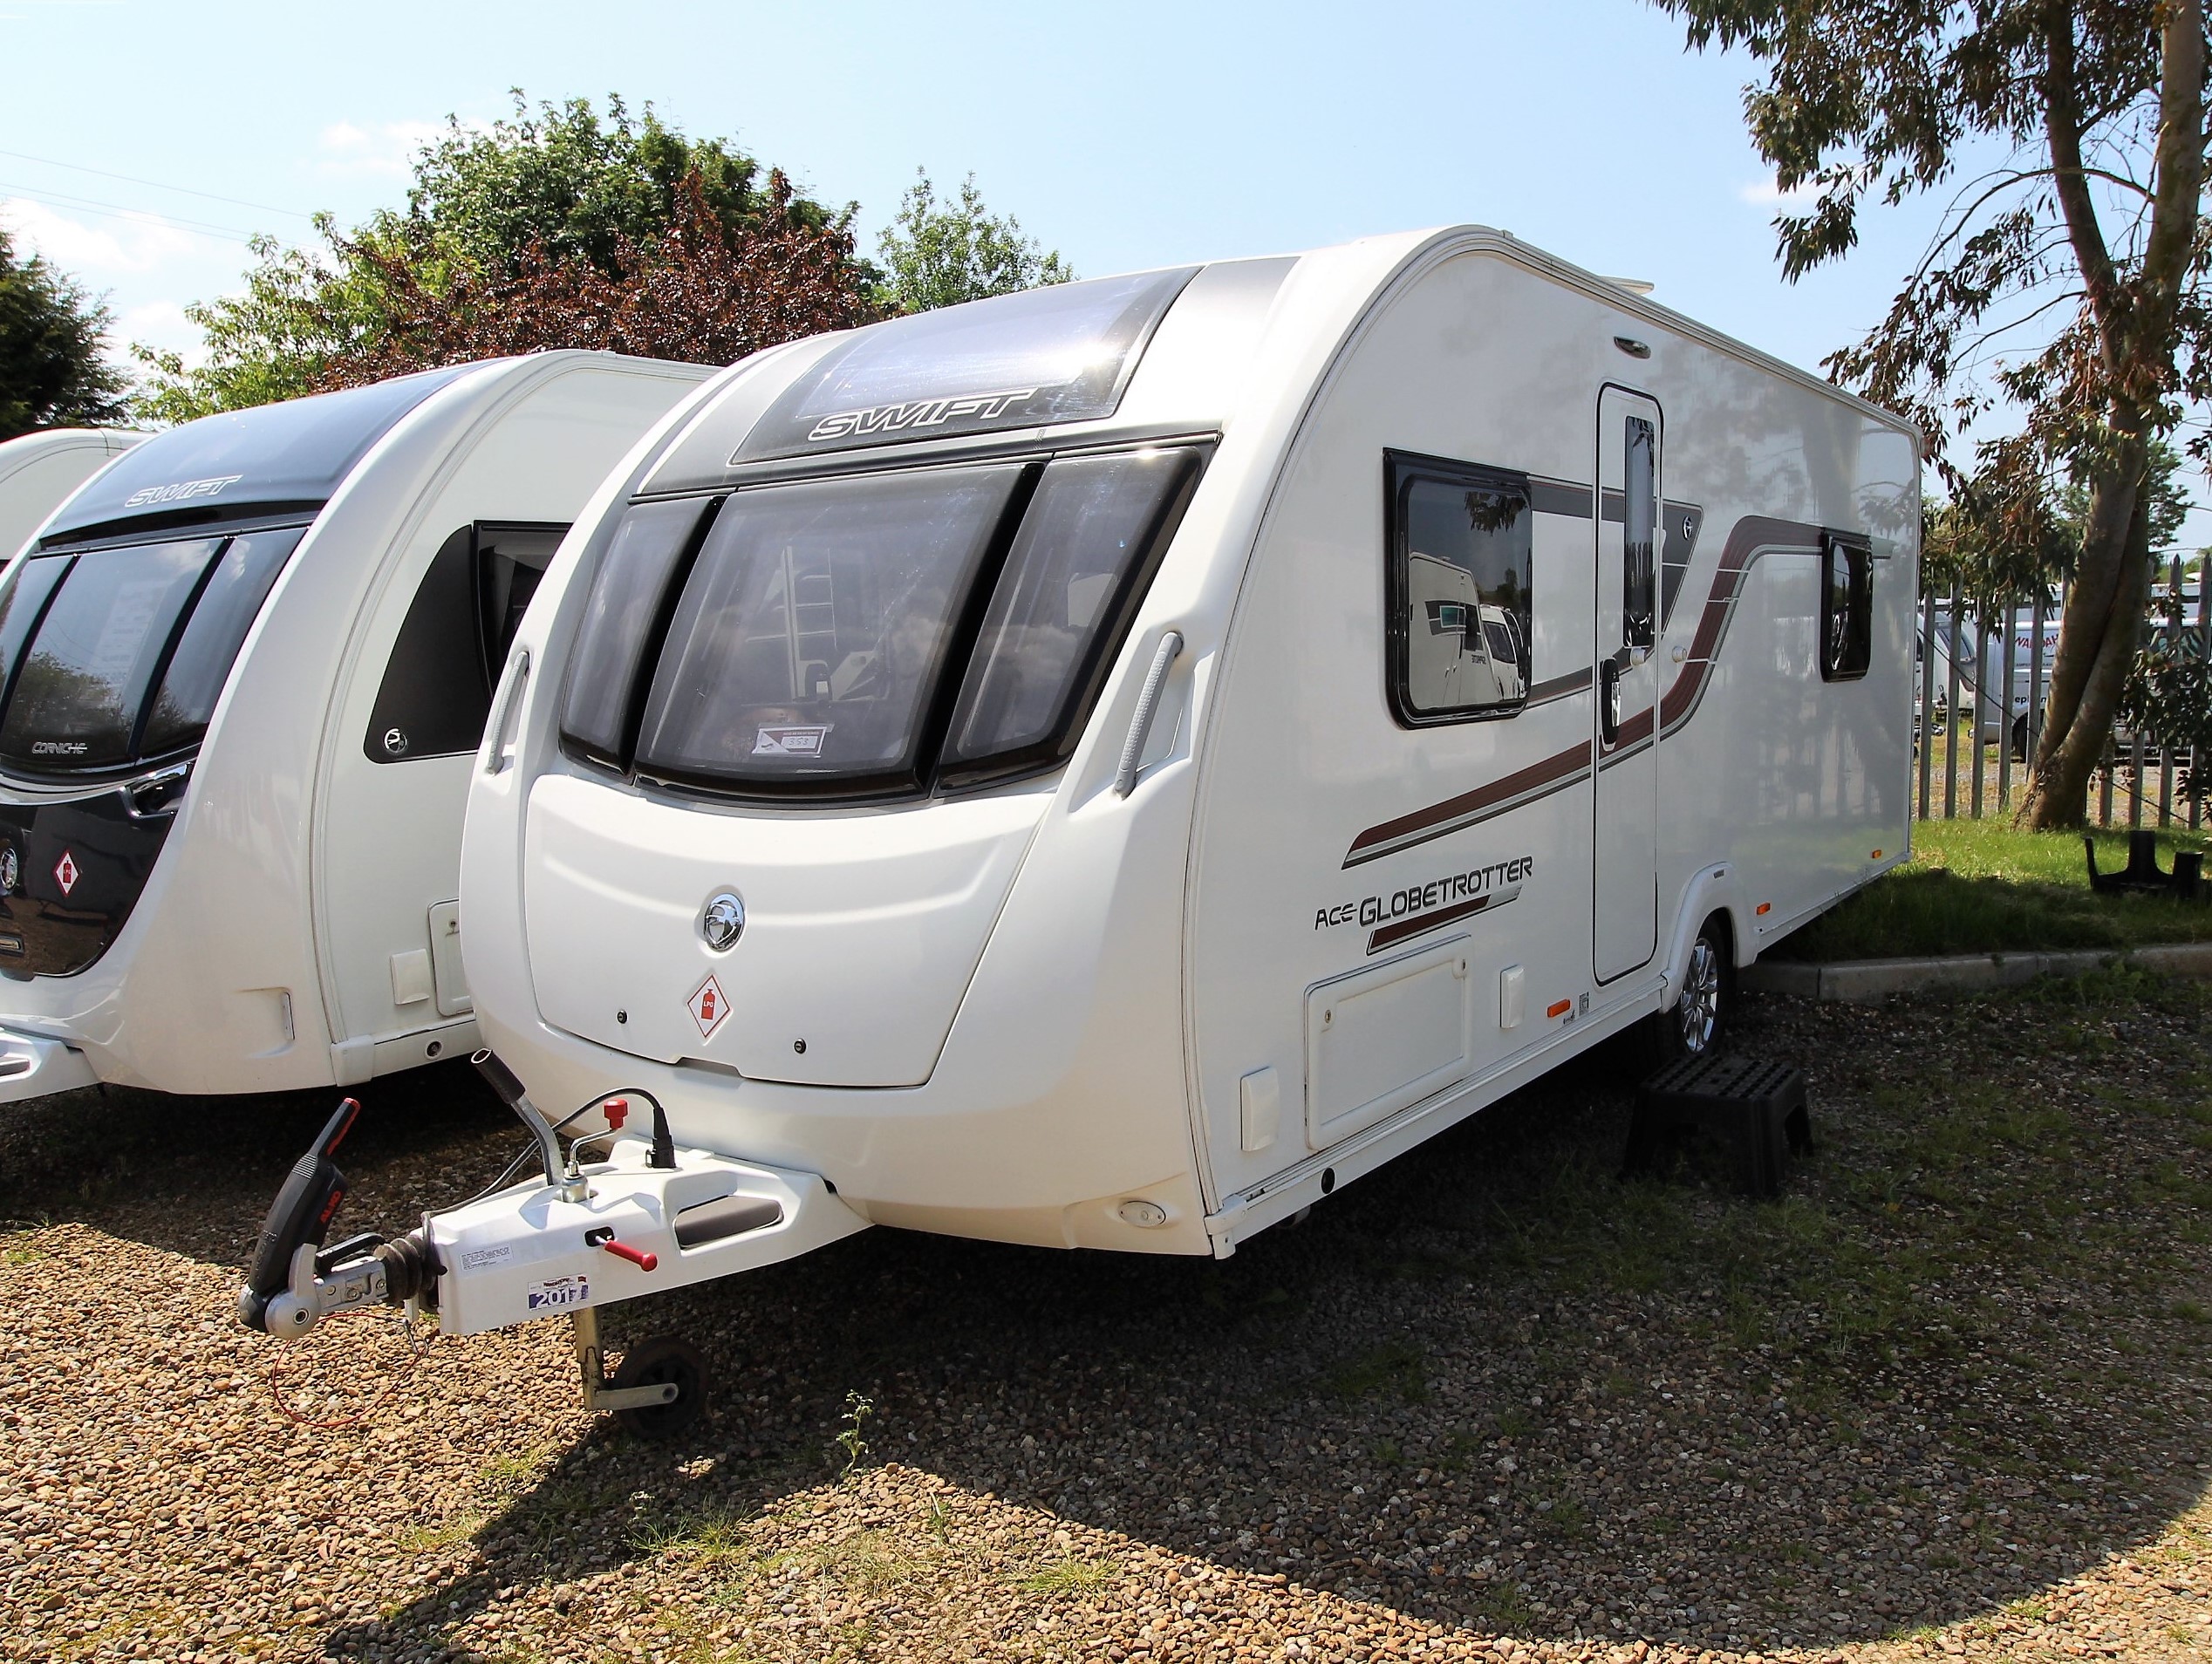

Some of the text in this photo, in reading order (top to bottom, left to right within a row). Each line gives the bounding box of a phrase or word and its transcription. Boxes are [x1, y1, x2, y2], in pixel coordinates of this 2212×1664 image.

[808, 386, 1038, 442] SWIFT
[125, 474, 243, 508] SWIFT
[1314, 856, 1533, 931] ACE GLOBETROTTER
